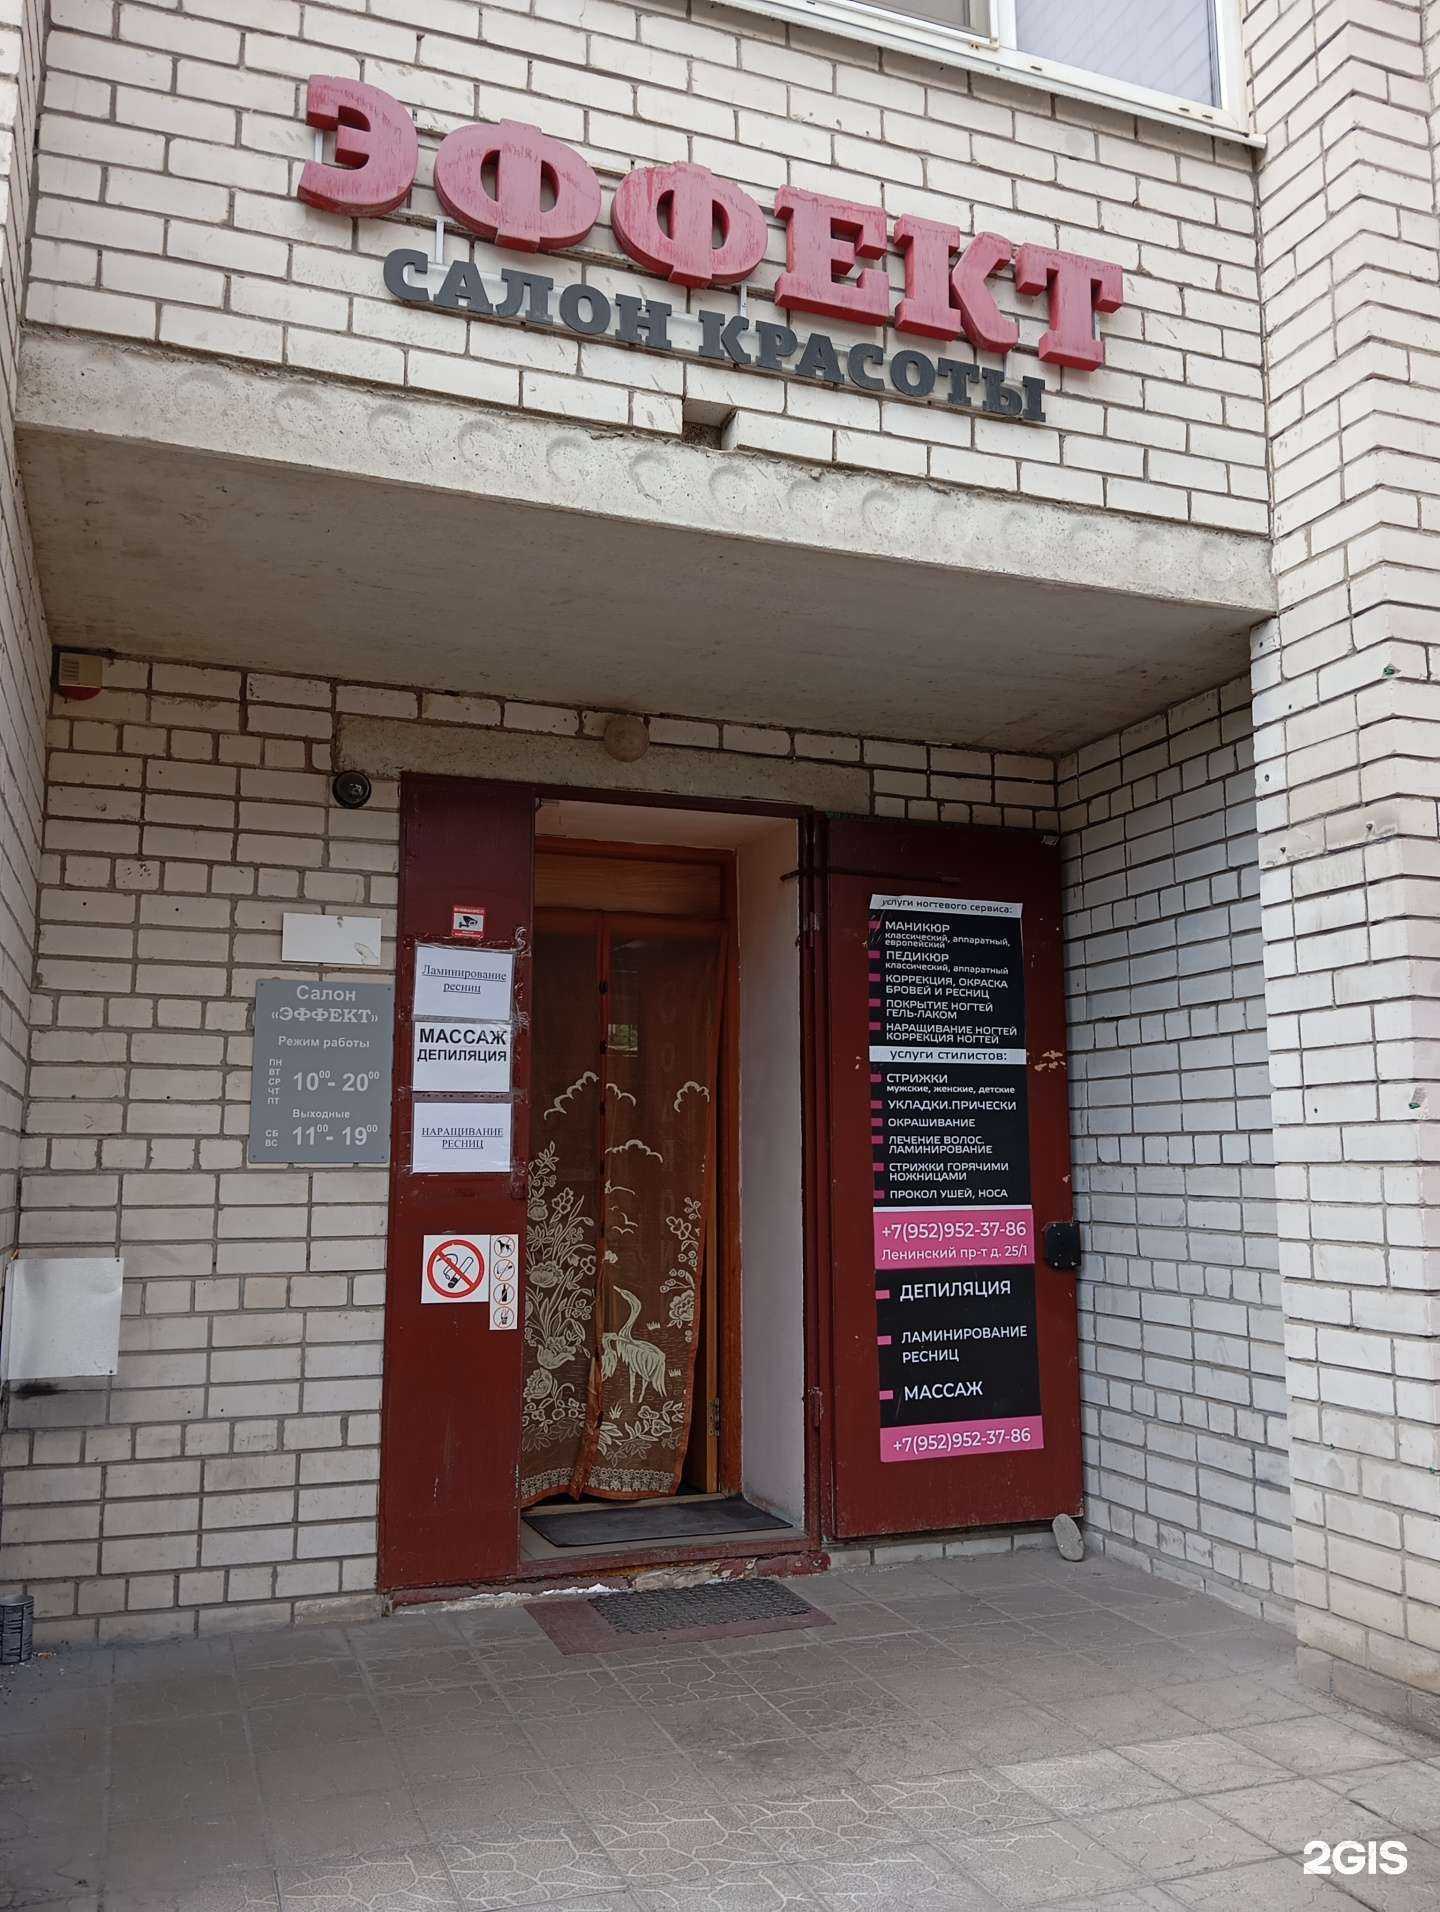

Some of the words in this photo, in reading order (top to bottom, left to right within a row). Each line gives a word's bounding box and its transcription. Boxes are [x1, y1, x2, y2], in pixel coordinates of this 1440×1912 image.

[298, 74, 1123, 371] ЭФФЕКТ
[383, 248, 673, 350] САЛОН
[698, 309, 1046, 422] КРАСОТЫ
[880, 899, 913, 907] услуги
[916, 901, 967, 910] ногтевого
[970, 904, 1012, 913] сервиса:
[885, 921, 950, 933] МАНИКЮР
[885, 932, 950, 943] классический,
[953, 936, 1010, 947] аппаратный,
[885, 939, 945, 949] европейский
[886, 951, 949, 962] ПЕДИКЮР
[422, 964, 507, 981] Ламинирование
[885, 962, 950, 972] классический,
[953, 966, 1009, 975] аппаратный
[443, 983, 481, 993] ресниц
[885, 975, 956, 987] КОРРЕКЦИЯ,
[959, 978, 1008, 989] ОКРАСКА
[296, 985, 356, 1001] Салон
[886, 984, 931, 995] БРОВЕЙ
[934, 987, 943, 996] И
[945, 988, 990, 999] РЕСНИЦ
[886, 1000, 948, 1010] ПОКРЫТИЕ
[951, 1001, 993, 1012] НОГТЕЙ
[271, 1006, 378, 1023] «ЭФФЕКТ»
[886, 1009, 957, 1019] ГЕЛЬ-ЛАКОМ
[886, 1023, 973, 1034] НАРАЩИВАНИЕ
[975, 1024, 1017, 1036] НОГТЕЙ
[278, 1036, 320, 1047] Режим
[323, 1037, 370, 1049] работы
[419, 1028, 506, 1045] МАССАЖ
[886, 1033, 954, 1043] КОРРЕКЦИЯ
[957, 1034, 999, 1044] НОГТЕЙ
[416, 1048, 507, 1063] ДЕПИЛЯЦИЯ
[890, 1050, 933, 1061] услуги
[937, 1051, 1007, 1061] стилистов:
[269, 1068, 280, 1076] ВТ
[886, 1074, 948, 1083] СТРИЖКИ
[933, 1086, 976, 1094] женские,
[978, 1086, 1015, 1094] детские
[292, 1109, 350, 1119] Выходные
[888, 1118, 976, 1127] ОКРАШИВАНИЕ
[421, 1127, 504, 1137] НАРАЩИВАНИЕ
[265, 1139, 278, 1147] ВС
[442, 1138, 484, 1149] РЕСНИЦ
[888, 1136, 940, 1144] ЛЕЧЕНИЕ
[889, 1145, 992, 1154] ЛАМИНИРОВАНИЕ
[889, 1163, 944, 1171] СТРИЖКИ
[947, 1162, 1009, 1171] ГОРЯЧИМИ
[890, 1172, 967, 1182] НОЖНИЦАМИ
[890, 1190, 937, 1199] ПРОКОЛ
[940, 1188, 975, 1199] УШЕЙ,
[978, 1189, 1008, 1198] НОСА
[882, 1221, 1027, 1242] +7(952)952-37-86
[882, 1247, 956, 1260] Ленинский
[960, 1248, 987, 1259] пр-т
[990, 1249, 1001, 1258] д.
[1005, 1245, 1027, 1257] 25/1
[899, 1280, 1011, 1302] ДЕПИЛЯЦИЯ
[901, 1325, 1027, 1344] ЛАМИНИРОВАНИЕ
[902, 1349, 959, 1363] РЕСНИЦ
[904, 1381, 983, 1401] МАССАЖ
[893, 1428, 1031, 1455] +7(952)952-37-86
